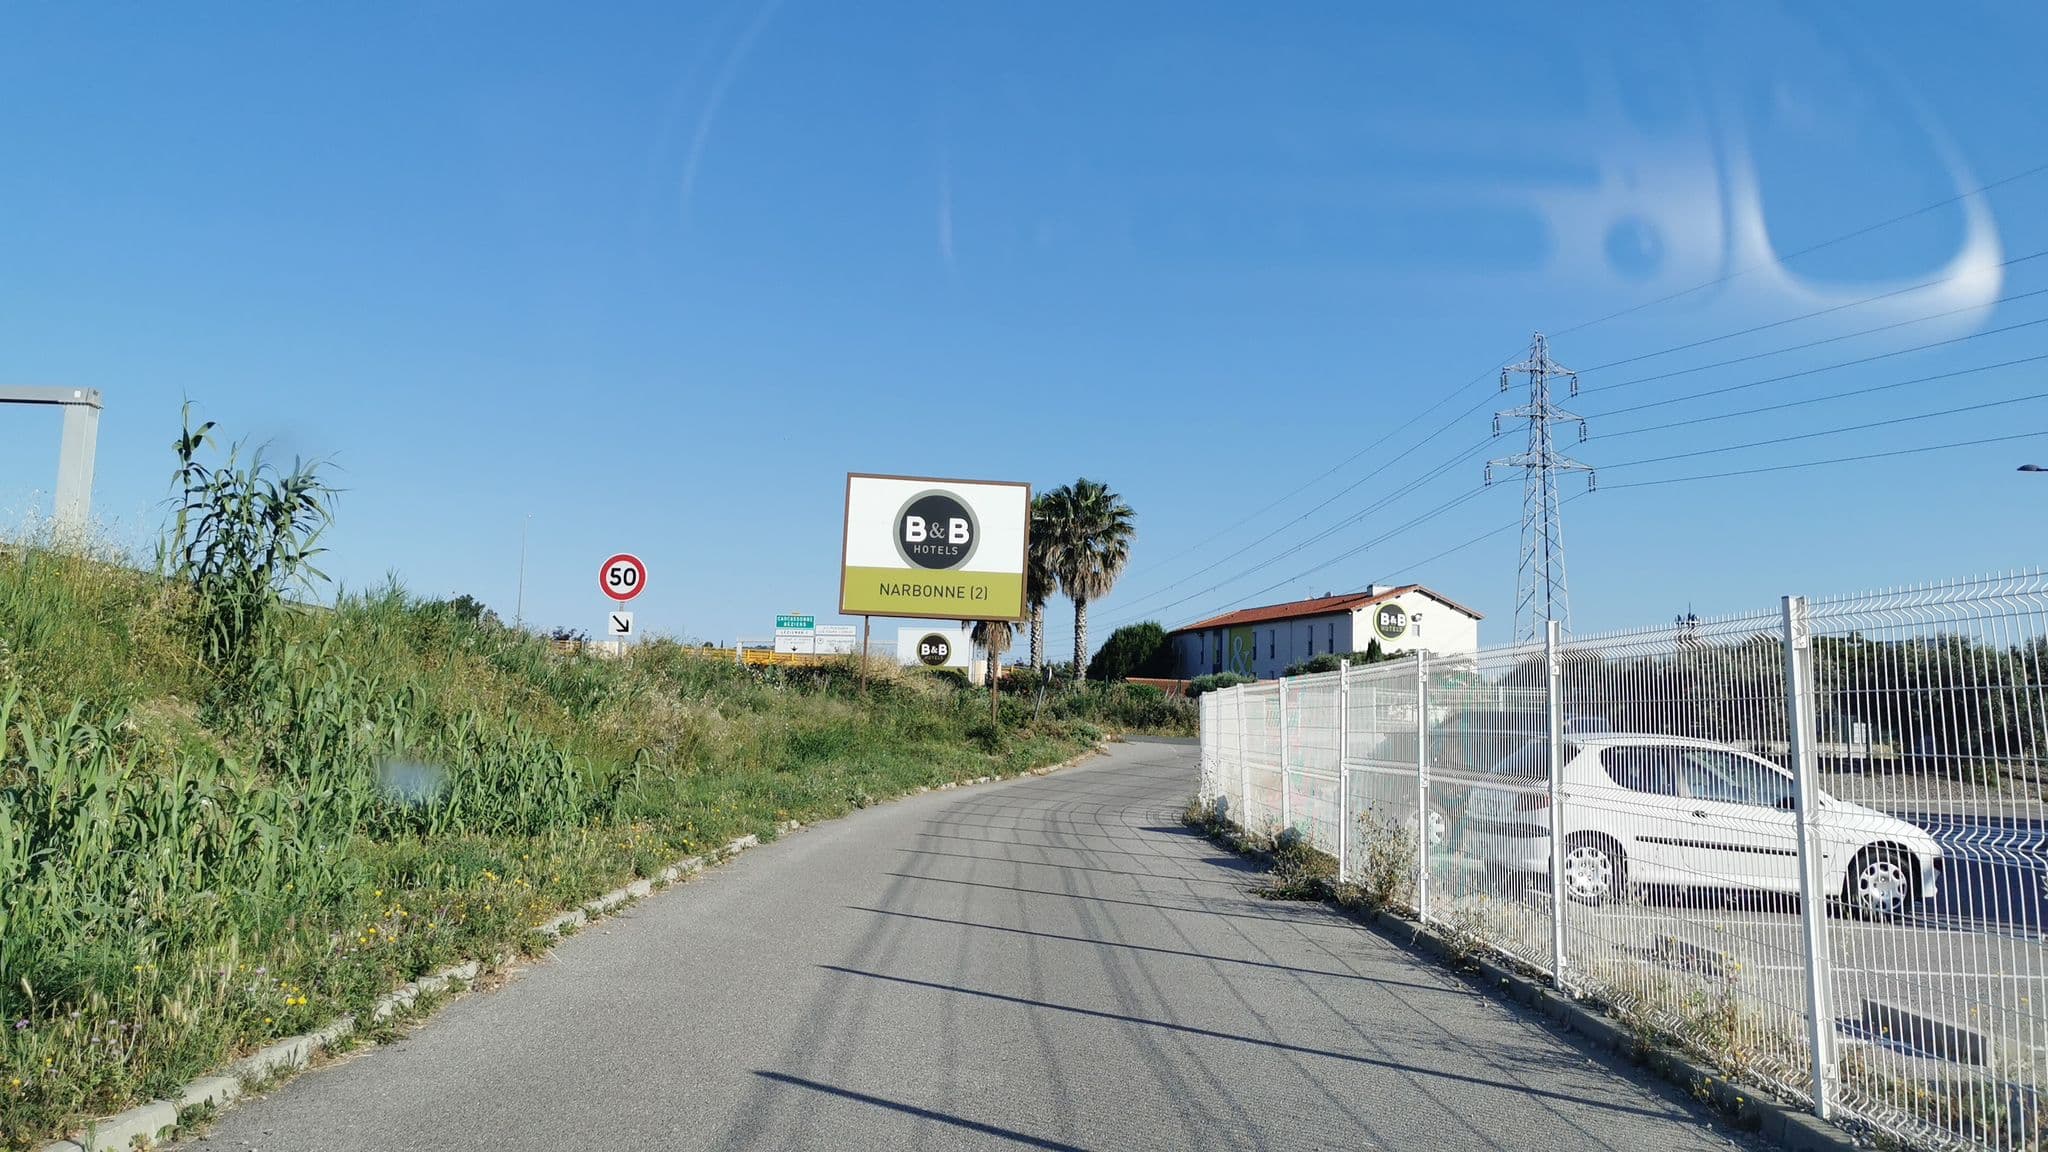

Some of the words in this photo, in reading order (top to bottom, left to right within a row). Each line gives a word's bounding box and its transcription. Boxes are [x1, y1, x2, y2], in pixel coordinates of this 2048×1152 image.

[913, 544, 958, 555] HOTELS
[609, 567, 637, 586] 50
[879, 583, 966, 599] NARBONNE
[970, 585, 988, 600] (2)
[921, 643, 948, 656] B&B
